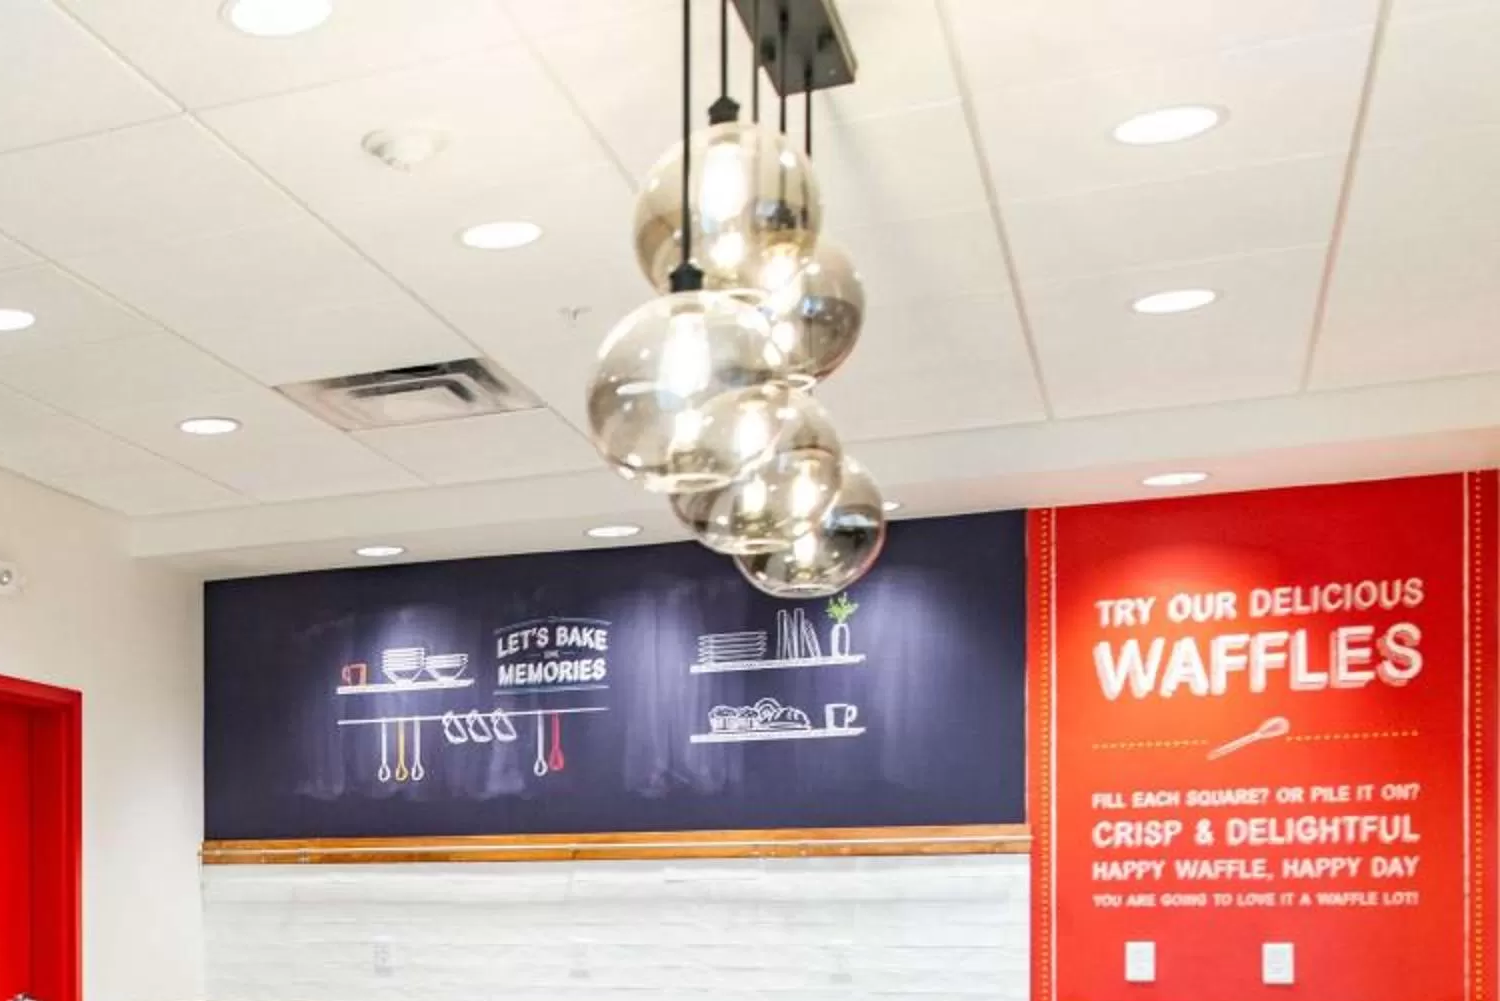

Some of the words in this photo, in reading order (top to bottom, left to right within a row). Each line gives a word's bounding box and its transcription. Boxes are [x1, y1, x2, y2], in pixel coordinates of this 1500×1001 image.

[1094, 596, 1156, 628] TRY
[1168, 591, 1237, 624] OUR
[1249, 577, 1424, 618] DELICIOUS
[496, 627, 549, 659] LET'S
[556, 626, 608, 651] BAKE
[498, 658, 607, 687] MEMORIES
[1092, 622, 1424, 702] WAFFLES
[1092, 792, 1125, 809] FILL
[1132, 790, 1180, 808] EACH
[1186, 786, 1269, 807] SQUARE?
[1276, 786, 1304, 804] OR
[1310, 785, 1351, 803] PILE
[1357, 784, 1375, 801] IT
[1380, 783, 1420, 801] ON?
[1092, 820, 1182, 848] CRISP
[1194, 818, 1214, 845] &
[1226, 814, 1421, 846] DELIGHTFUL
[1092, 860, 1165, 880] HAPPY
[1174, 858, 1274, 881] WAFFLE,
[1282, 857, 1362, 879] HAPPY
[1371, 855, 1420, 878] DAY
[1093, 893, 1122, 907] YOU
[1126, 893, 1157, 907] ARE
[1213, 892, 1233, 907] TO
[1237, 892, 1275, 907] LOVE
[1280, 892, 1294, 907] IT
[1299, 892, 1312, 906] A
[1316, 891, 1379, 906] WAFFLE
